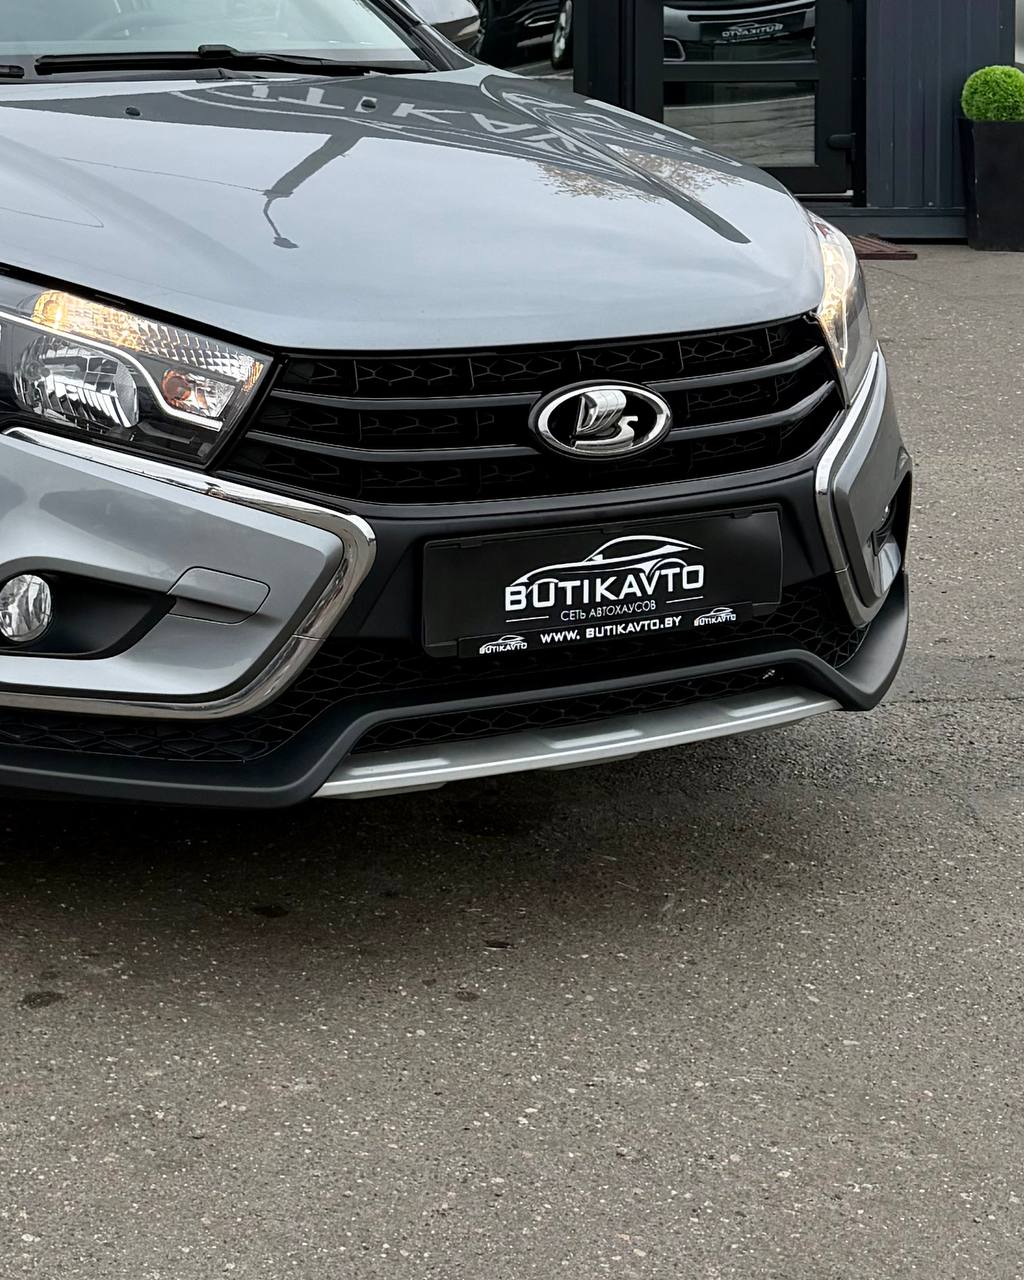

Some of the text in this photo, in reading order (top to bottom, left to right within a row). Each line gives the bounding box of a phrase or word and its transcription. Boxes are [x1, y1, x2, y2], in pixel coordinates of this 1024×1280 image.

[505, 565, 704, 611] BUTIKAVTO
[560, 600, 656, 621] СЕТЬ АВТОХАУСОВ
[694, 613, 736, 626] BUTIKAVTO
[540, 616, 681, 644] WWW. BUTIKAVTO.BY
[479, 642, 527, 654] BUTIKAVTO
